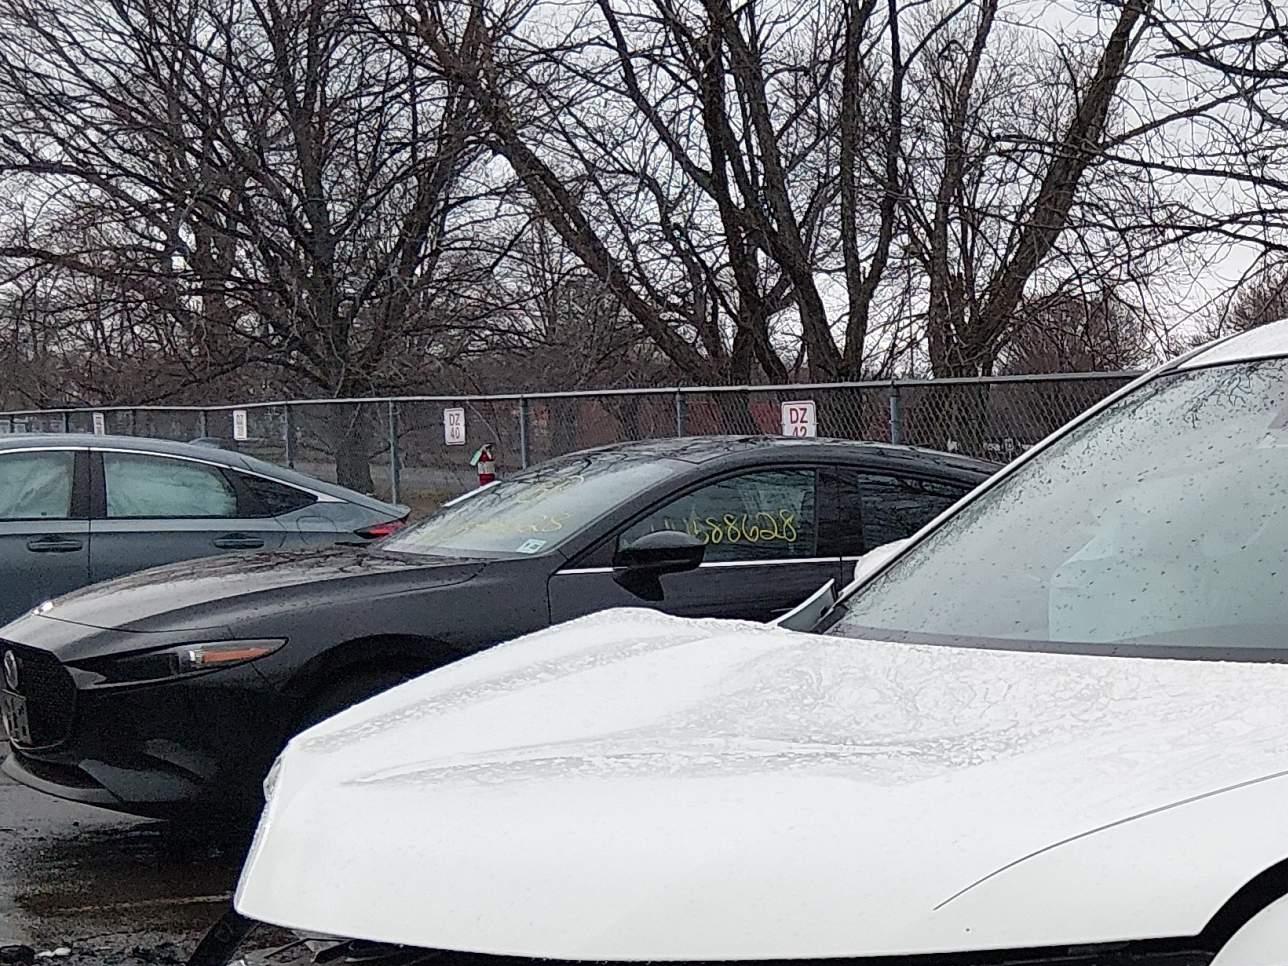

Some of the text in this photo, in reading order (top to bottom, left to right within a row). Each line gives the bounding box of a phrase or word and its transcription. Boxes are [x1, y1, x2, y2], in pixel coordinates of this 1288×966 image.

[448, 413, 461, 427] DZ
[789, 407, 809, 425] DZ
[450, 427, 461, 440] 40
[792, 426, 808, 438] 42
